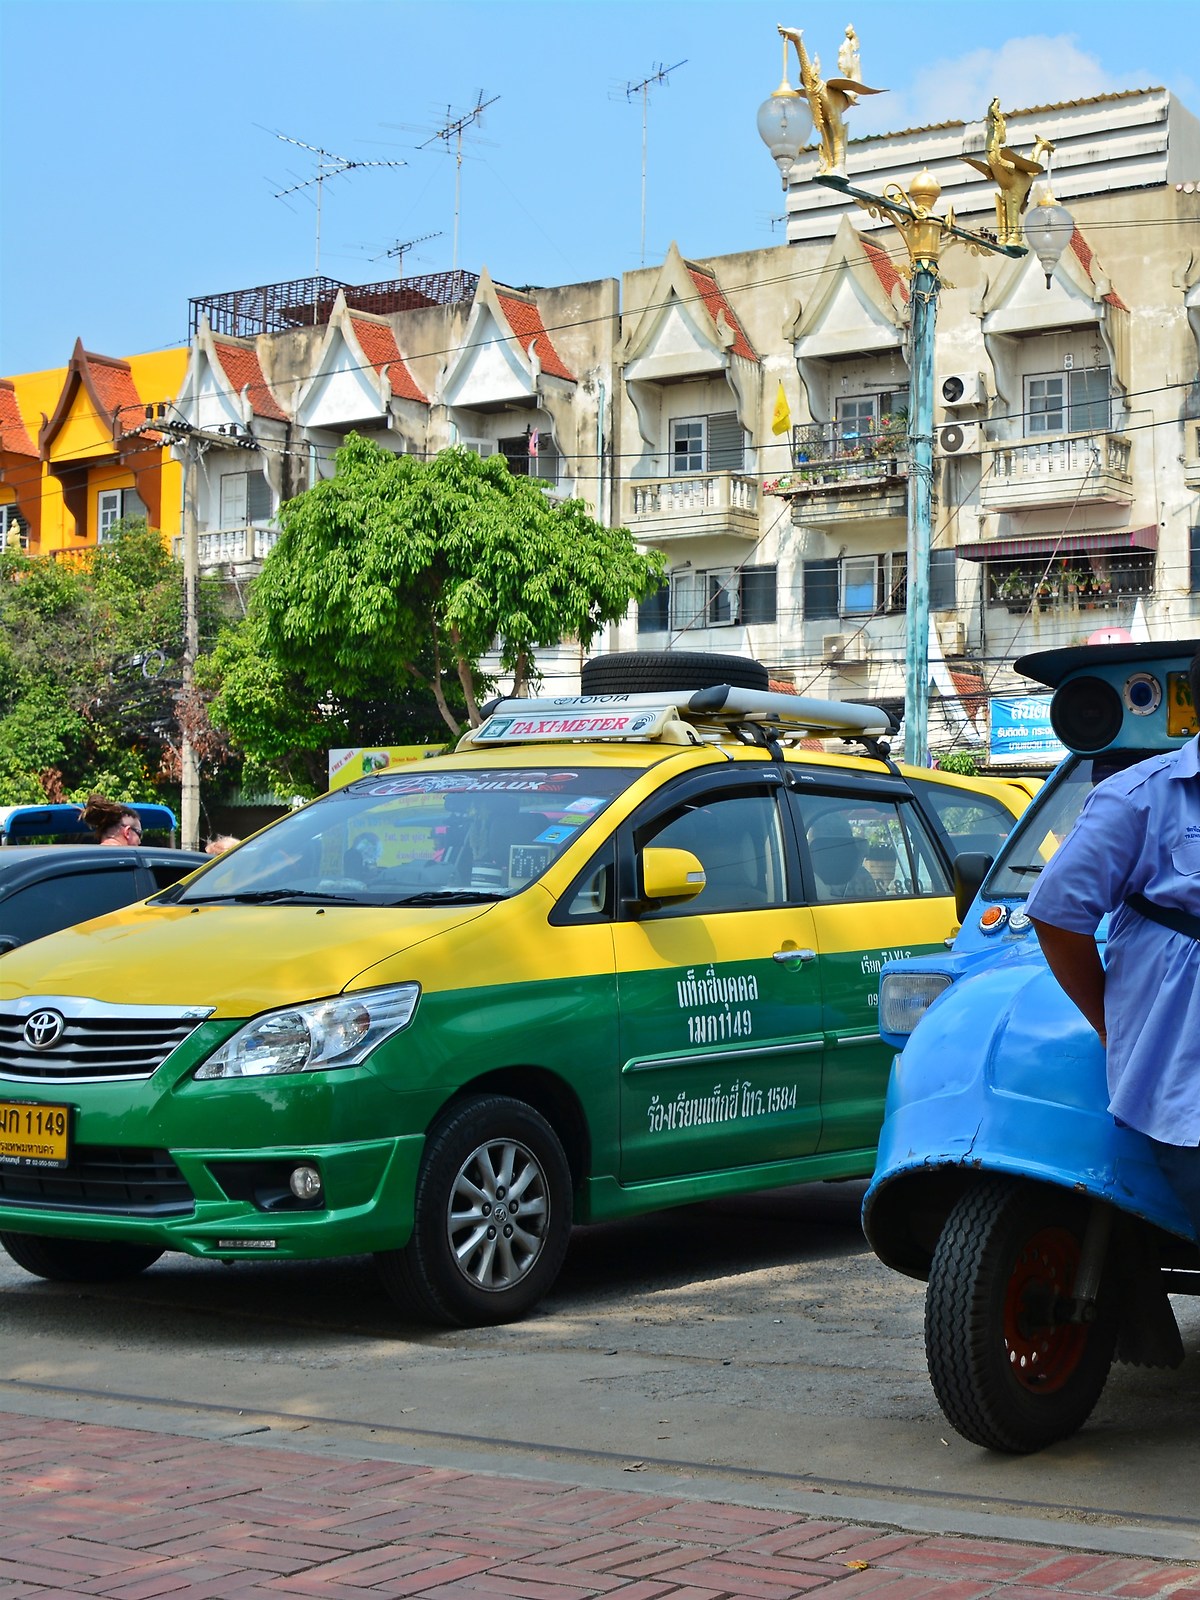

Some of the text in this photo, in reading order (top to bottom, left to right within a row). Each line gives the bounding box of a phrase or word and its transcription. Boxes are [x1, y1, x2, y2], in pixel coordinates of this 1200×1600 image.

[573, 694, 630, 705] TOYOTA
[466, 781, 546, 790] HILUX
[677, 963, 759, 1011] แท็กซี่บุคคล
[687, 1009, 752, 1044] 1มก1149
[26, 1110, 65, 1136] 1149
[0, 1142, 55, 1155] รุงเทพมหานคร
